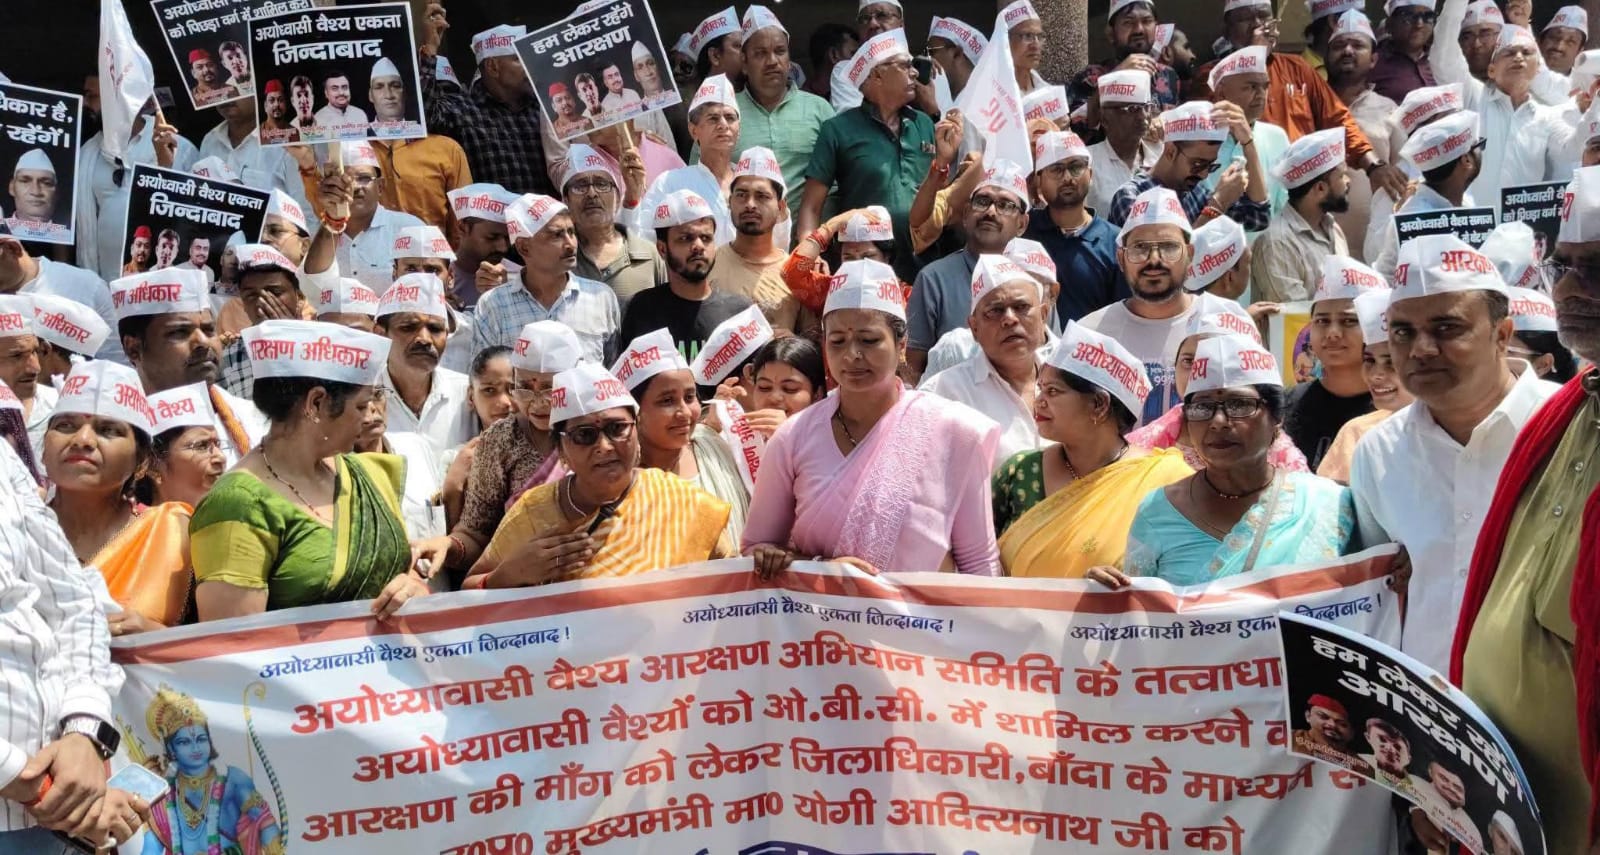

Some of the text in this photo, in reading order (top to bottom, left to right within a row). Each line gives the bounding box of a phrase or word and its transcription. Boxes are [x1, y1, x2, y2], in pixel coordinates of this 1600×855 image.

[168, 24, 187, 39] को
[187, 18, 221, 35] पिछड़ा
[222, 9, 241, 26] वर्ग
[315, 13, 351, 32] वैश्य
[353, 14, 402, 31] एकता
[530, 1, 635, 55] हम लेकर रहेंगे
[272, 39, 383, 66] जिन्दाबाद
[552, 25, 631, 68] आरक्षण
[149, 191, 245, 230] जिन्दाबाद
[198, 181, 227, 203] वैश्य
[228, 191, 265, 211] एकता
[469, 193, 507, 215] अधिका
[127, 280, 183, 306] अधिकार
[41, 312, 92, 345] अधिकार
[300, 335, 373, 371] अधिकार
[632, 345, 660, 369] वैश्य
[702, 333, 746, 381] अयोध्यावासी
[1071, 341, 1138, 394] अयोध्यावासी
[157, 396, 195, 421] वैश्य
[682, 596, 779, 625] अयोध्यावासी
[781, 595, 816, 616] वैश्य
[817, 605, 861, 625] एकता
[1070, 620, 1184, 643] अयोध्यावासी
[1187, 611, 1232, 639] वैश्य
[259, 645, 376, 680] अयोध्यावासी
[379, 633, 417, 664] वैश्य
[422, 640, 473, 665] एकता
[290, 630, 1283, 735] अयोध्यावासी वैश्य आरक्षण अभियान समिति के तत्वाधा
[1310, 635, 1368, 671] हम
[1376, 661, 1461, 732] लेकर
[353, 708, 590, 783] अयोध्यावासी
[600, 694, 697, 742] वैश्यों
[700, 689, 754, 726] को
[948, 699, 989, 729] में
[995, 709, 1136, 746] शामिल
[1141, 708, 1254, 748] करने
[1337, 671, 1509, 804] आरक्षण
[301, 796, 459, 842] आरक्षण
[467, 772, 524, 815] की
[534, 761, 614, 801] माँग
[623, 748, 678, 788] को
[686, 742, 784, 780] लेकर
[1123, 755, 1172, 795] के
[544, 793, 714, 855] मुख्यमंत्री
[792, 788, 877, 827] योगी
[887, 791, 1103, 846] आदित्यनाथ
[1110, 811, 1173, 851] जी
[1182, 815, 1245, 855] को
